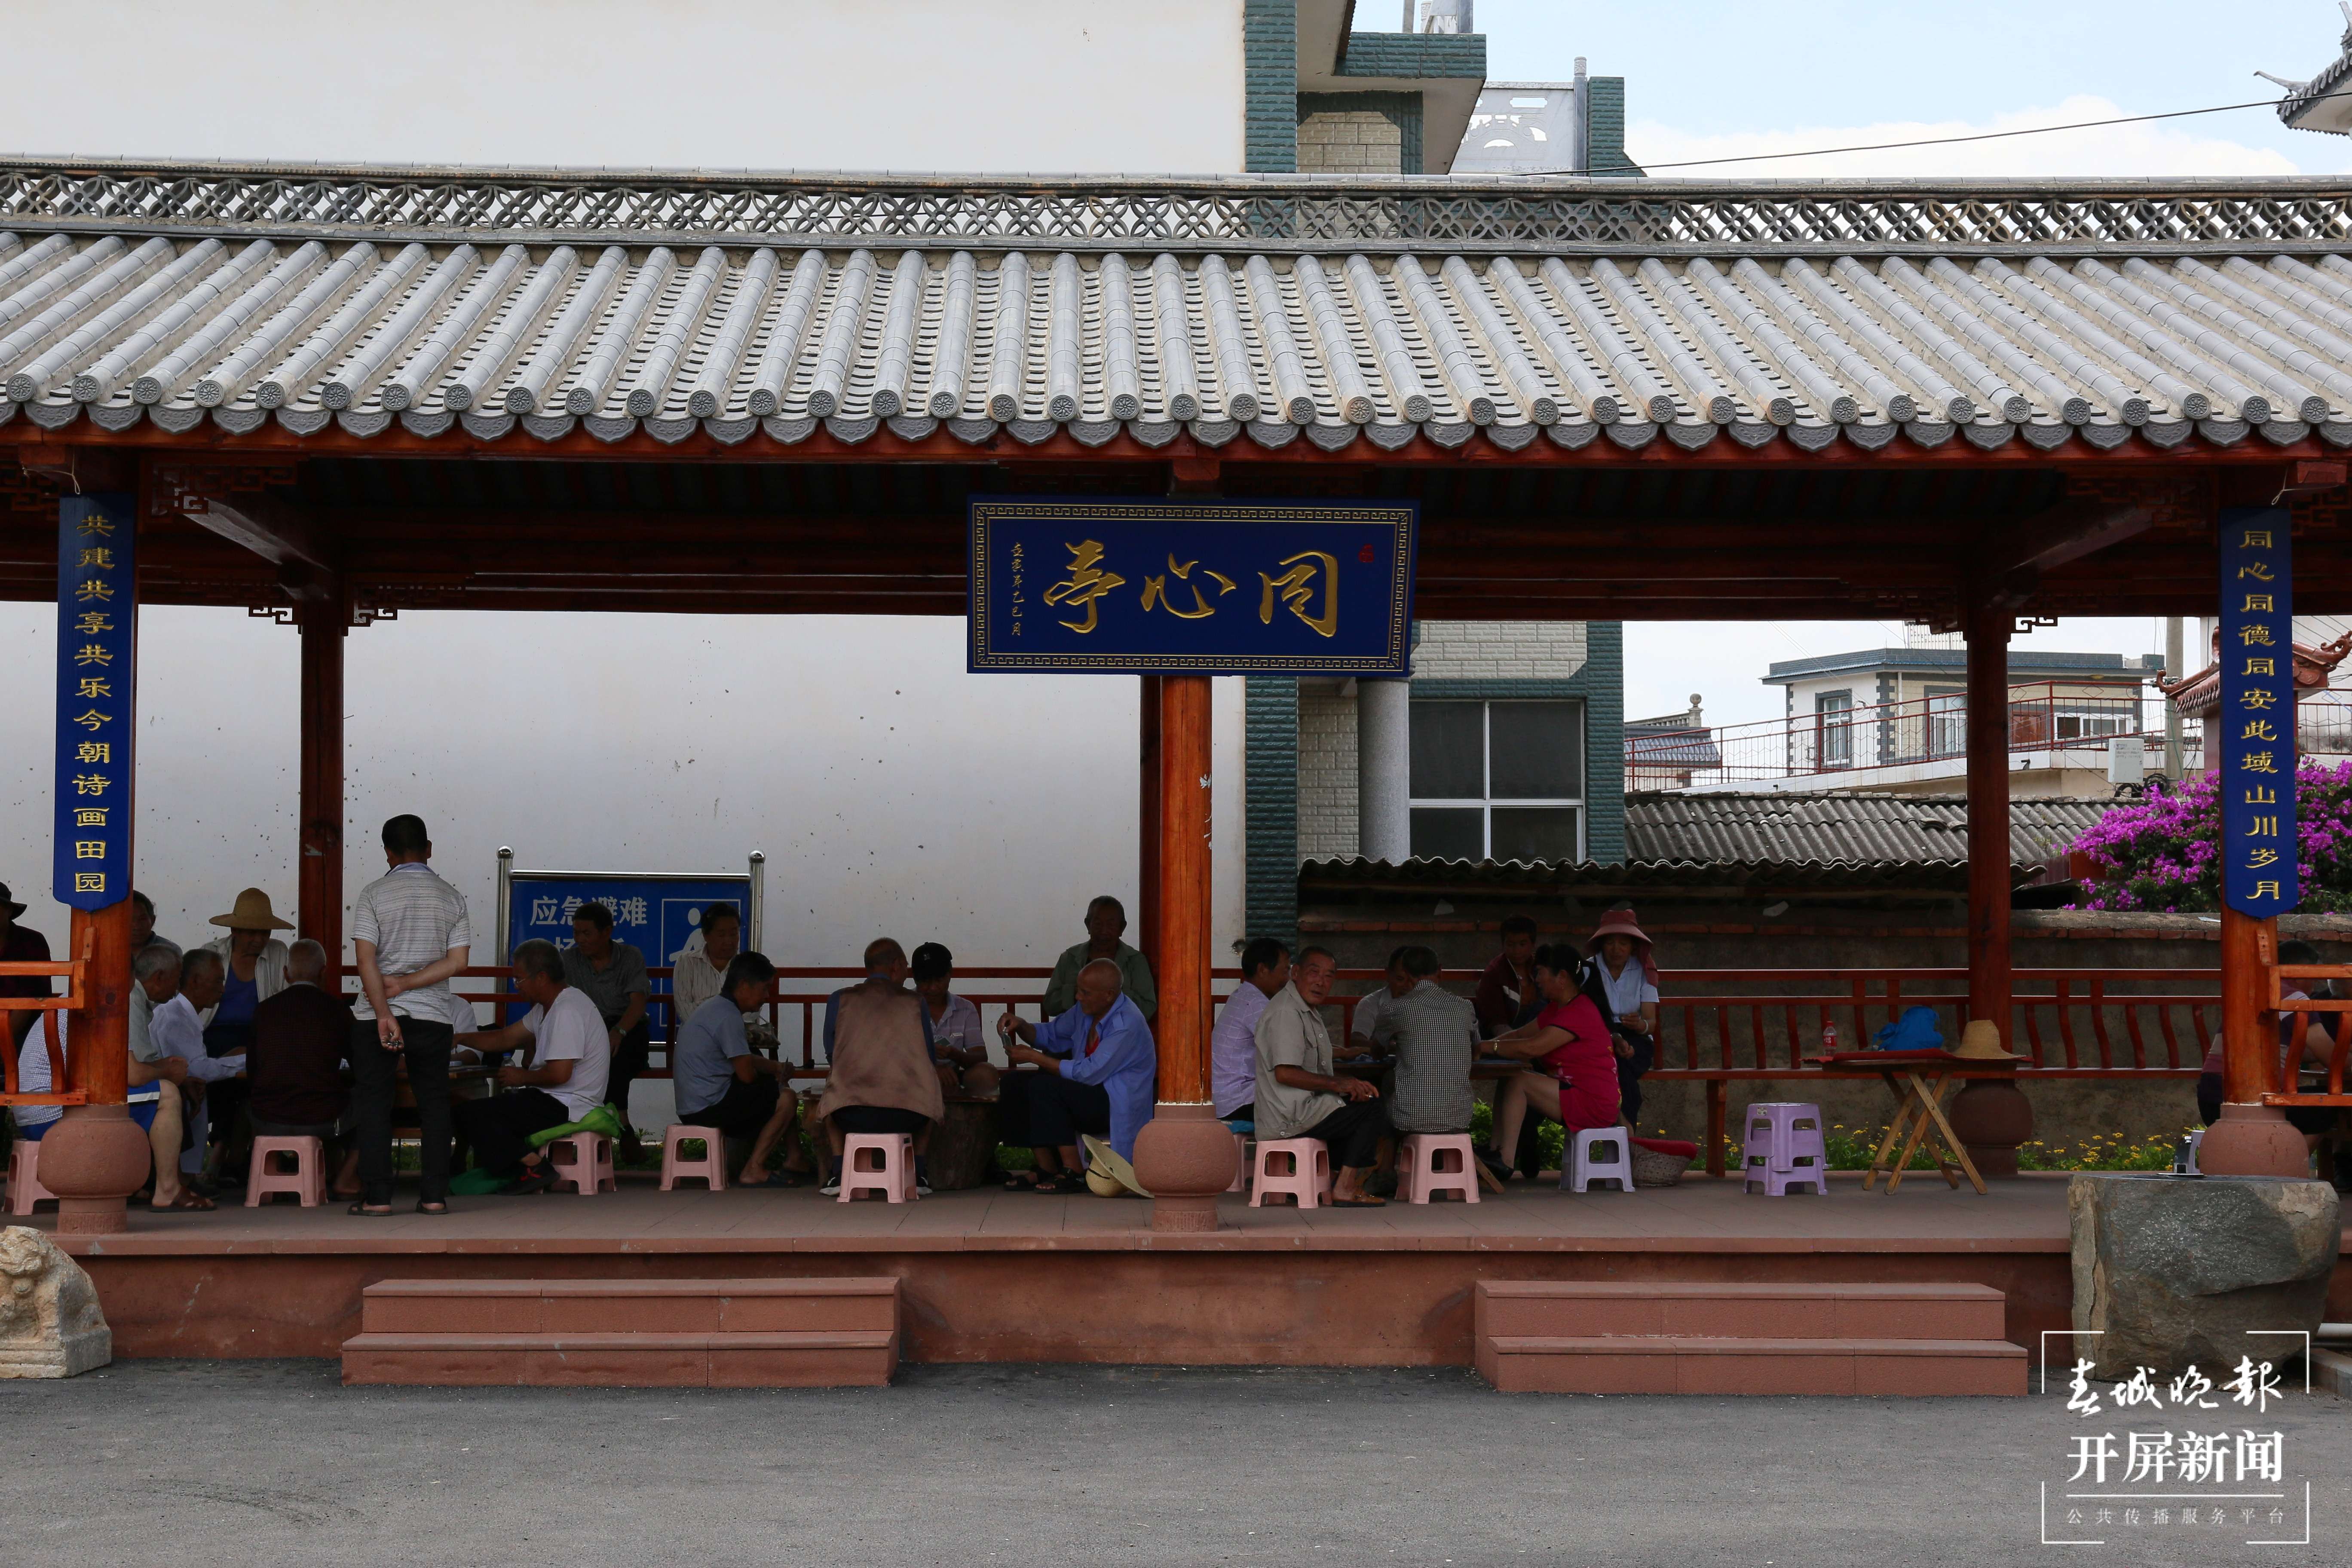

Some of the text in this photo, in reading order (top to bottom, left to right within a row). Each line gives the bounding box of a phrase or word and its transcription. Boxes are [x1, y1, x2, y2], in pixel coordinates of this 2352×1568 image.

[72, 515, 115, 892] 共建共享共乐今朝诗画田园
[2237, 530, 2280, 900] 同心同德同安此域山川岁月
